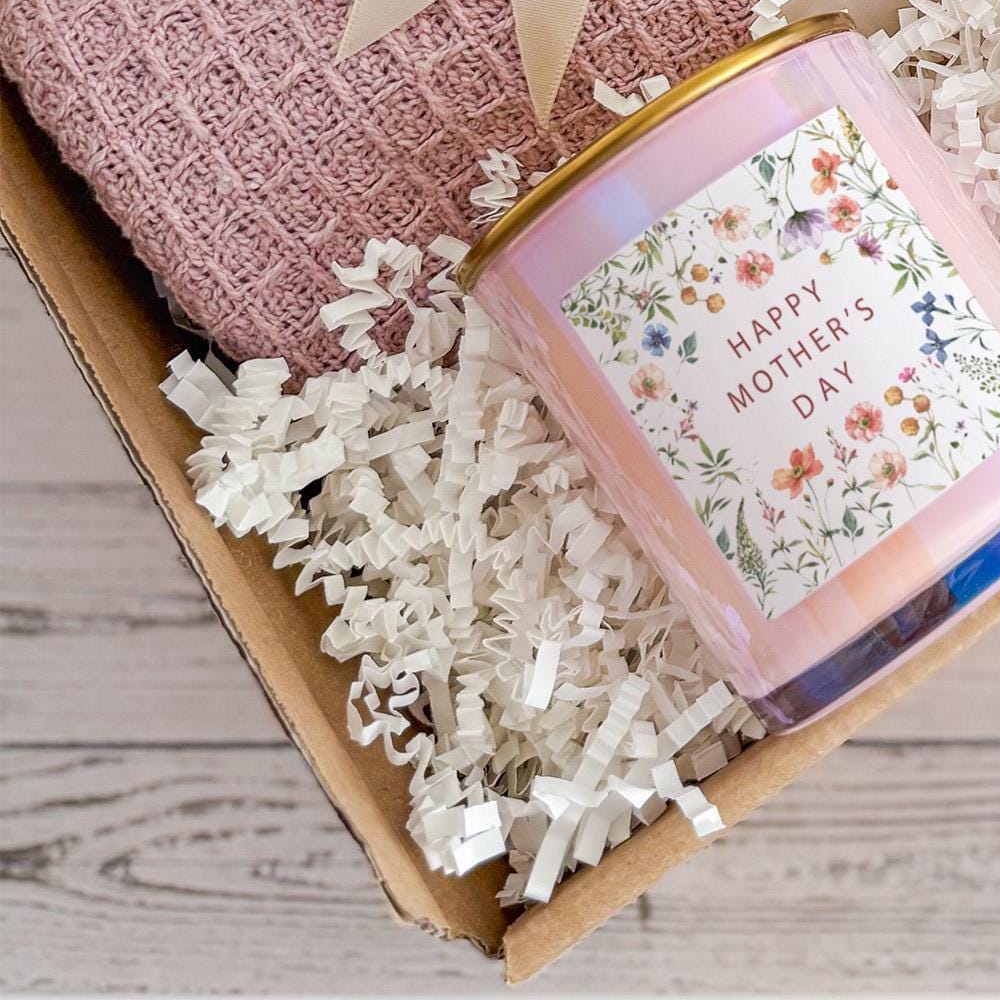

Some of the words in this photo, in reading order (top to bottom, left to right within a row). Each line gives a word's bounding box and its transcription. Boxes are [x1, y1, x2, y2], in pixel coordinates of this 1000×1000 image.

[726, 297, 874, 414] MOTHER'S
[727, 279, 821, 359] HAPPY
[791, 360, 853, 420] DAY
